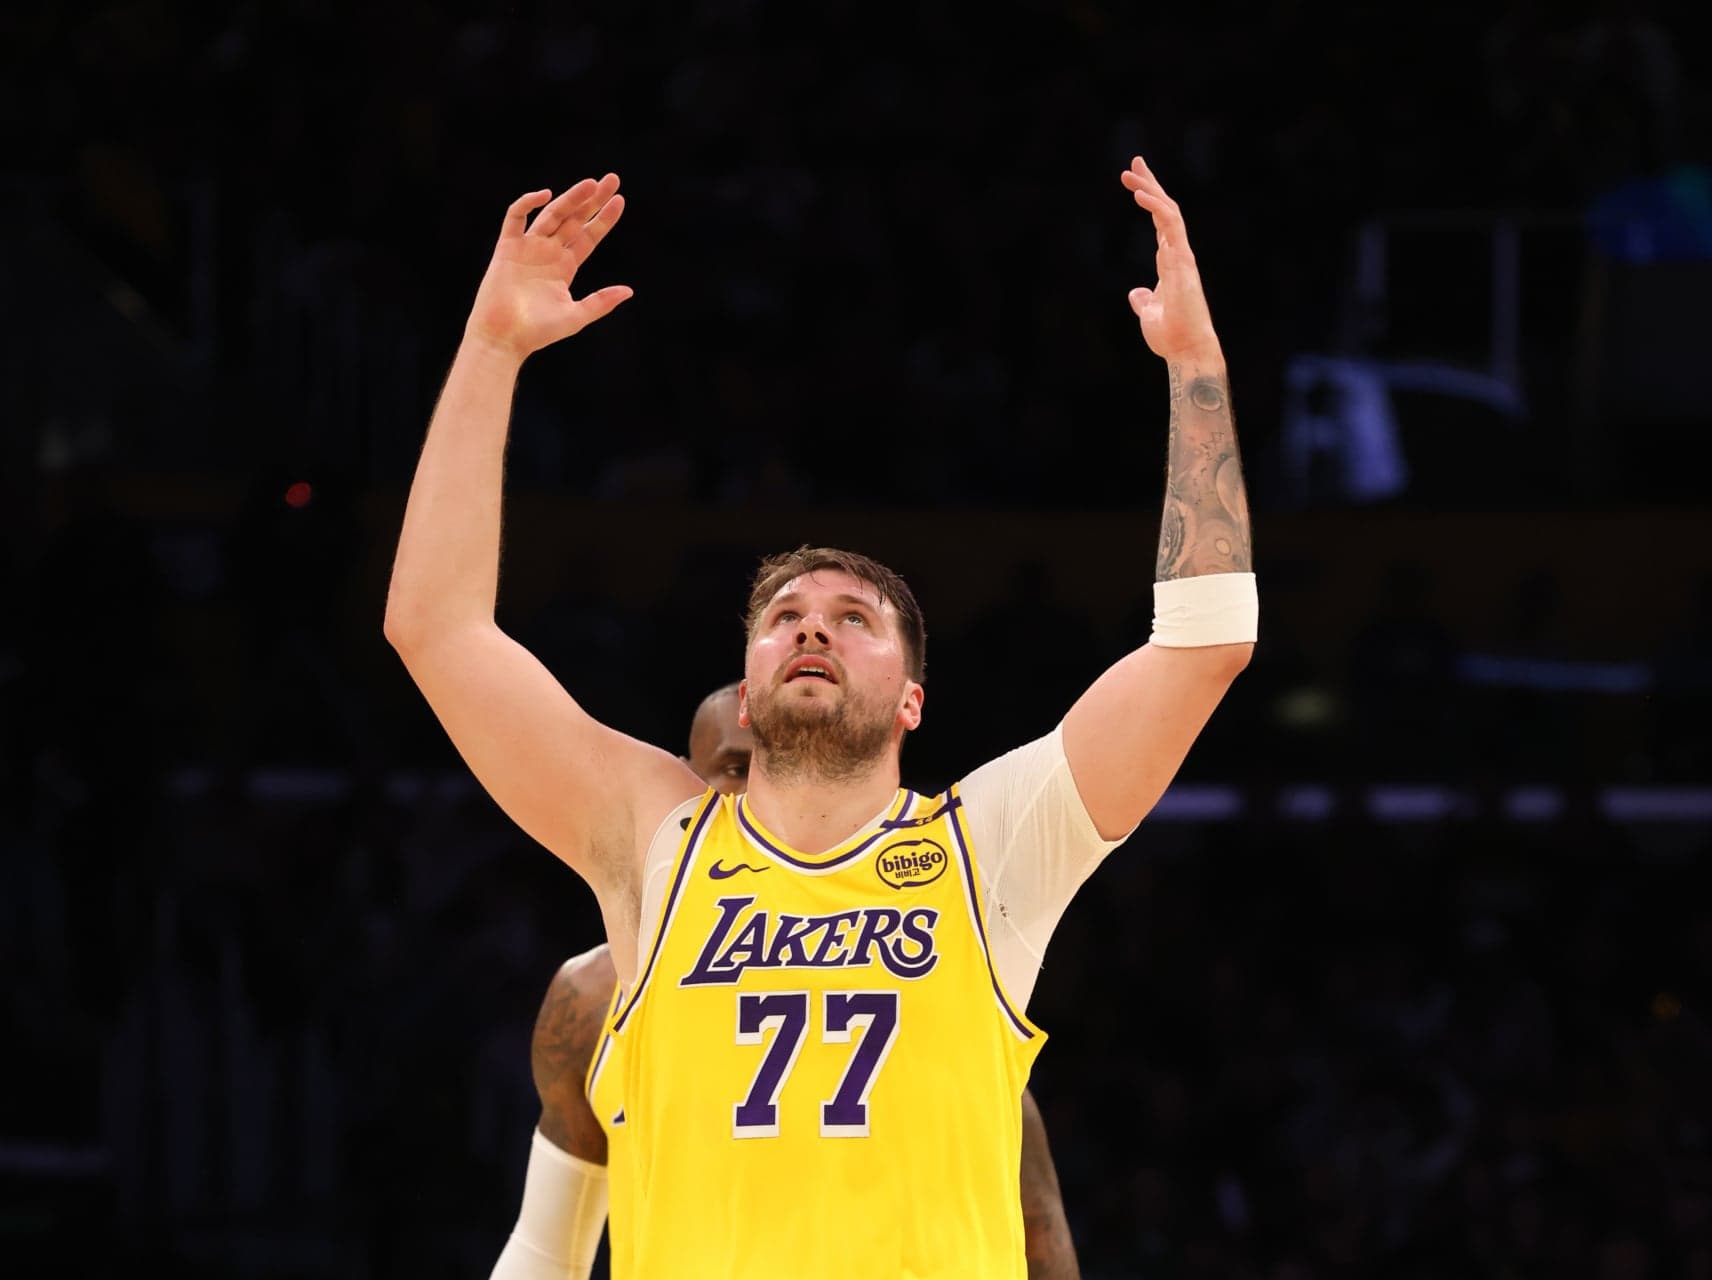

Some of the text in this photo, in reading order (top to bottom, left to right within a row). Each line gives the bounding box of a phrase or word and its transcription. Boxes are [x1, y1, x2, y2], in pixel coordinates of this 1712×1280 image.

[881, 852, 943, 872] bibigo
[678, 895, 940, 987] LAKERS
[732, 990, 901, 1139] 77
